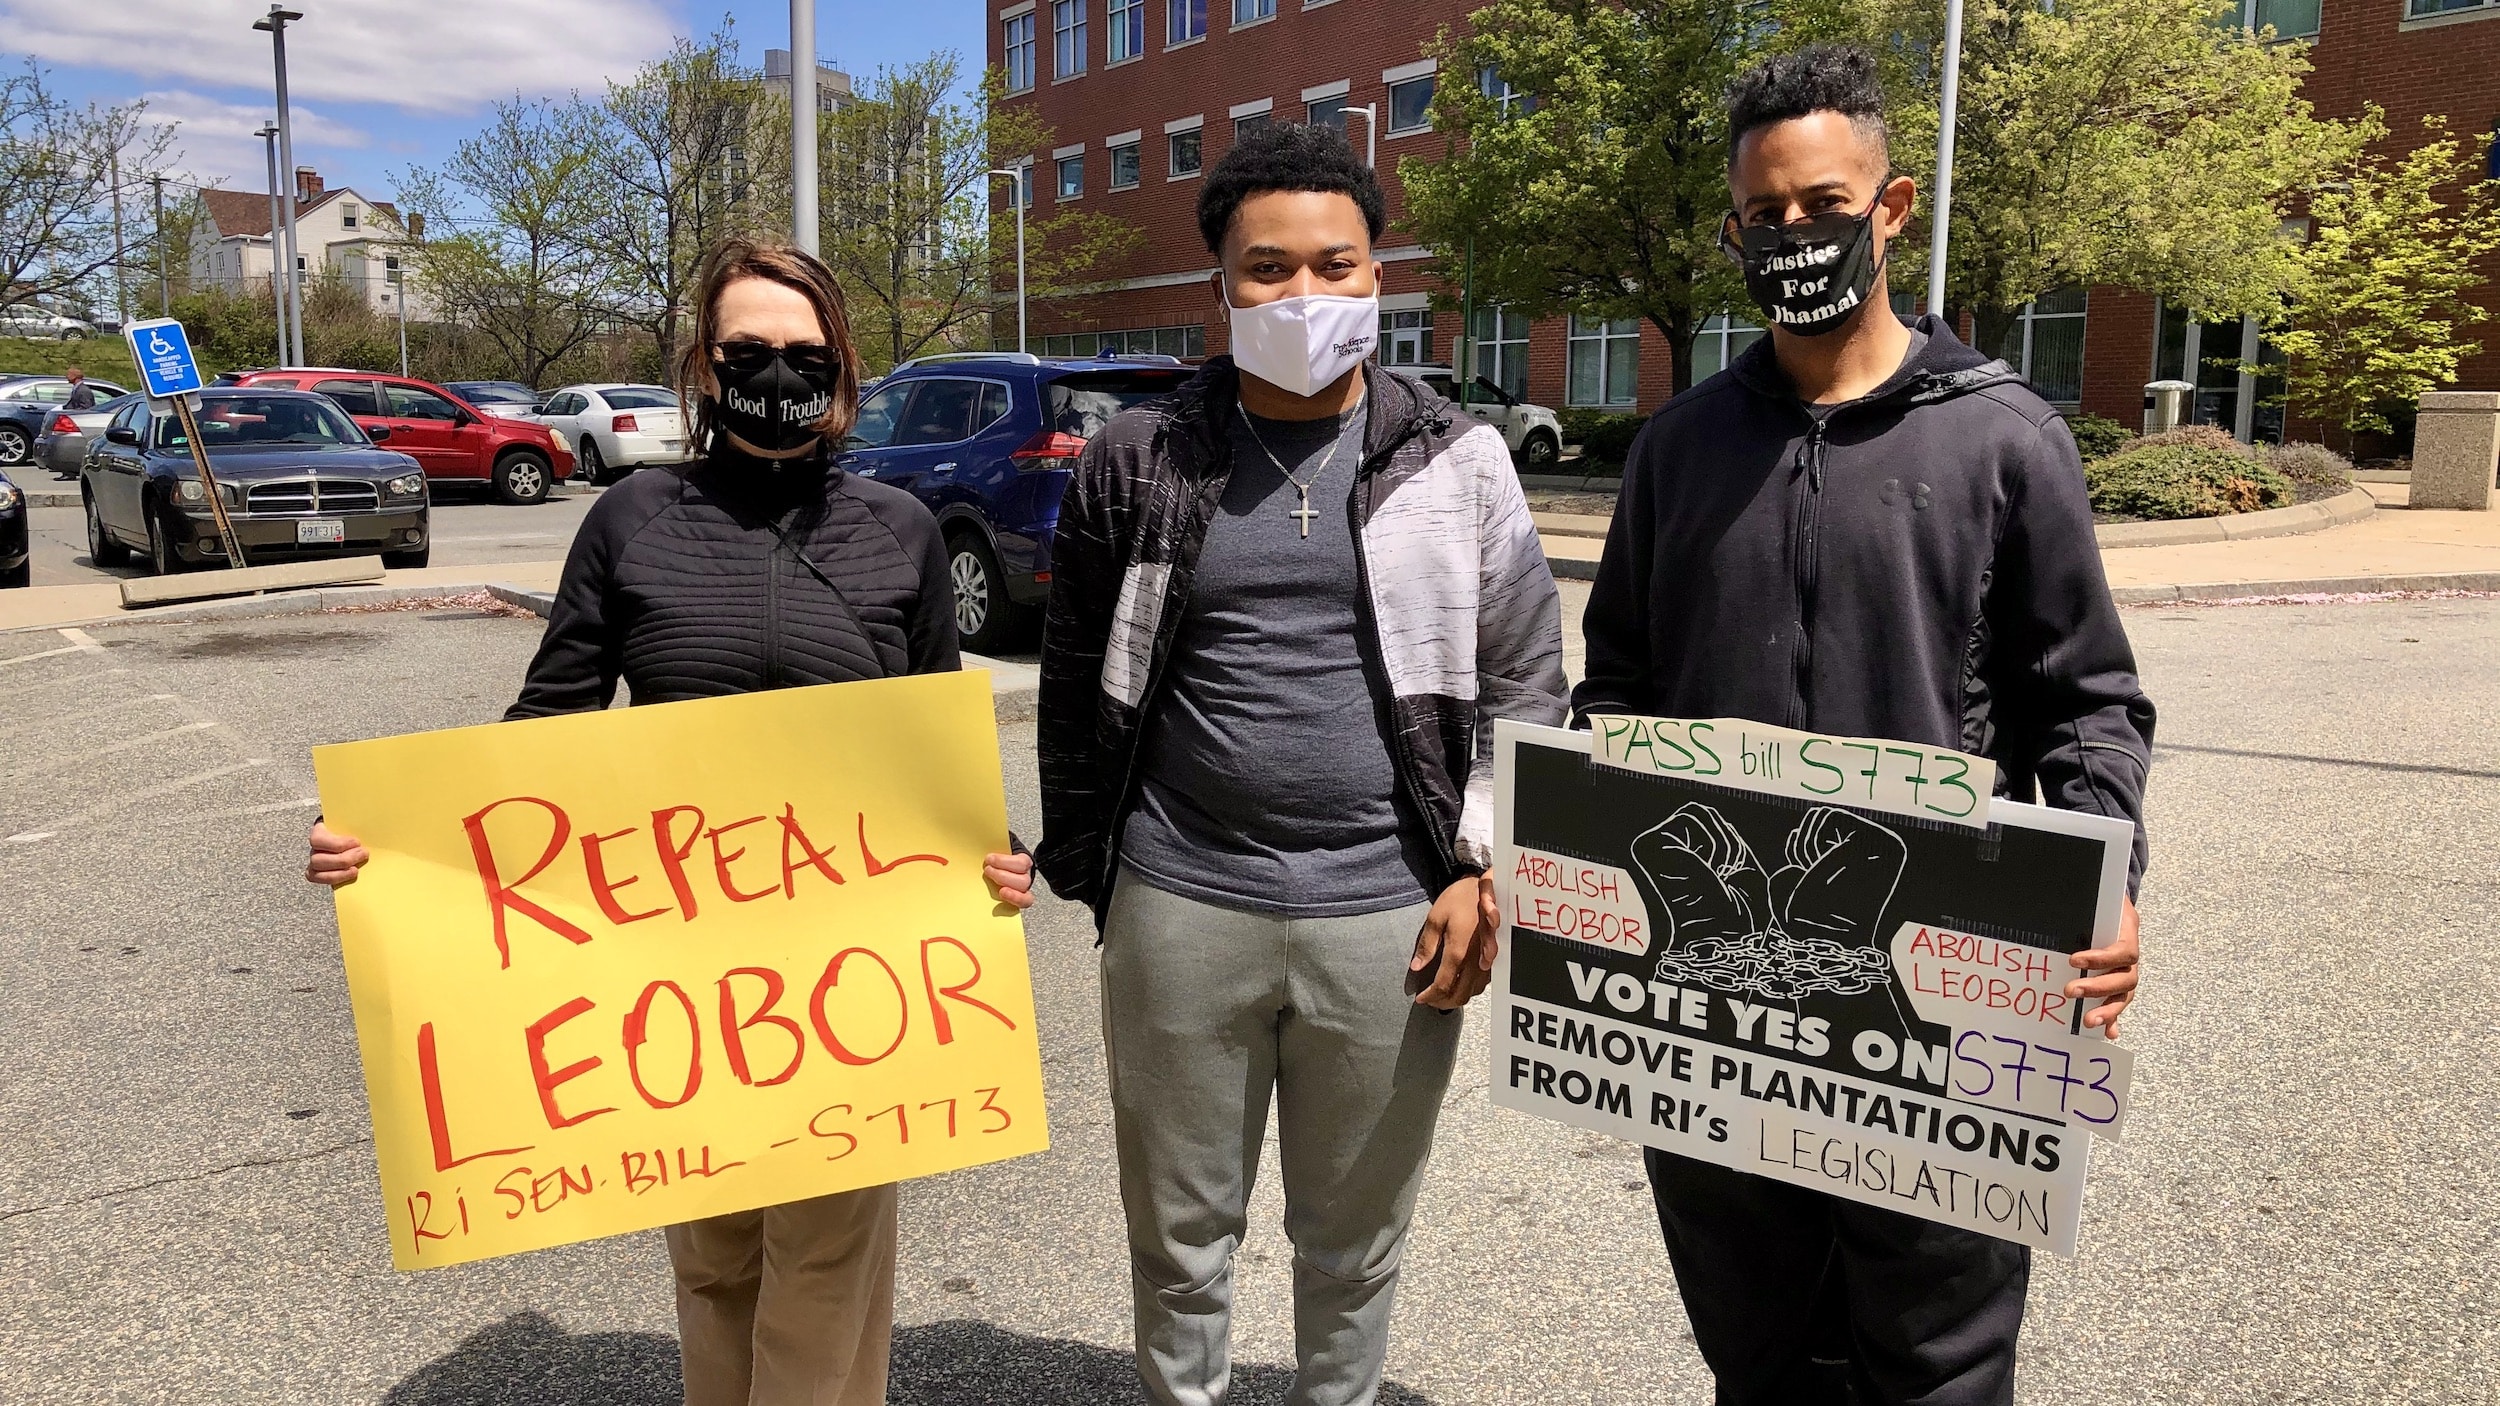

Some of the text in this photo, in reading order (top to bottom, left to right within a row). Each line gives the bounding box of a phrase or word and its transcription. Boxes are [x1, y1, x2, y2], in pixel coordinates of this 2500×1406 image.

[1760, 244, 1841, 276] Justice
[1781, 276, 1829, 299] For
[1771, 286, 1860, 324] Jhamal
[728, 387, 831, 422] Good Trouble
[1598, 717, 1977, 818] PASS bill S773
[462, 796, 949, 970] REPEAL
[1515, 851, 1619, 904] ABOLISH
[1516, 894, 1645, 949] LEOBOR
[1910, 927, 2053, 982] ABOLISH
[1914, 963, 2067, 1026] LEOBOR
[416, 936, 1017, 1172] LEOBOR
[1565, 960, 2119, 1124] VOTE YES ON S773
[1510, 1004, 2062, 1173] REMOVE PLANTATIONS
[622, 1145, 748, 1195] BILL
[1510, 1054, 2049, 1237] FROM RI's LEGISLATION
